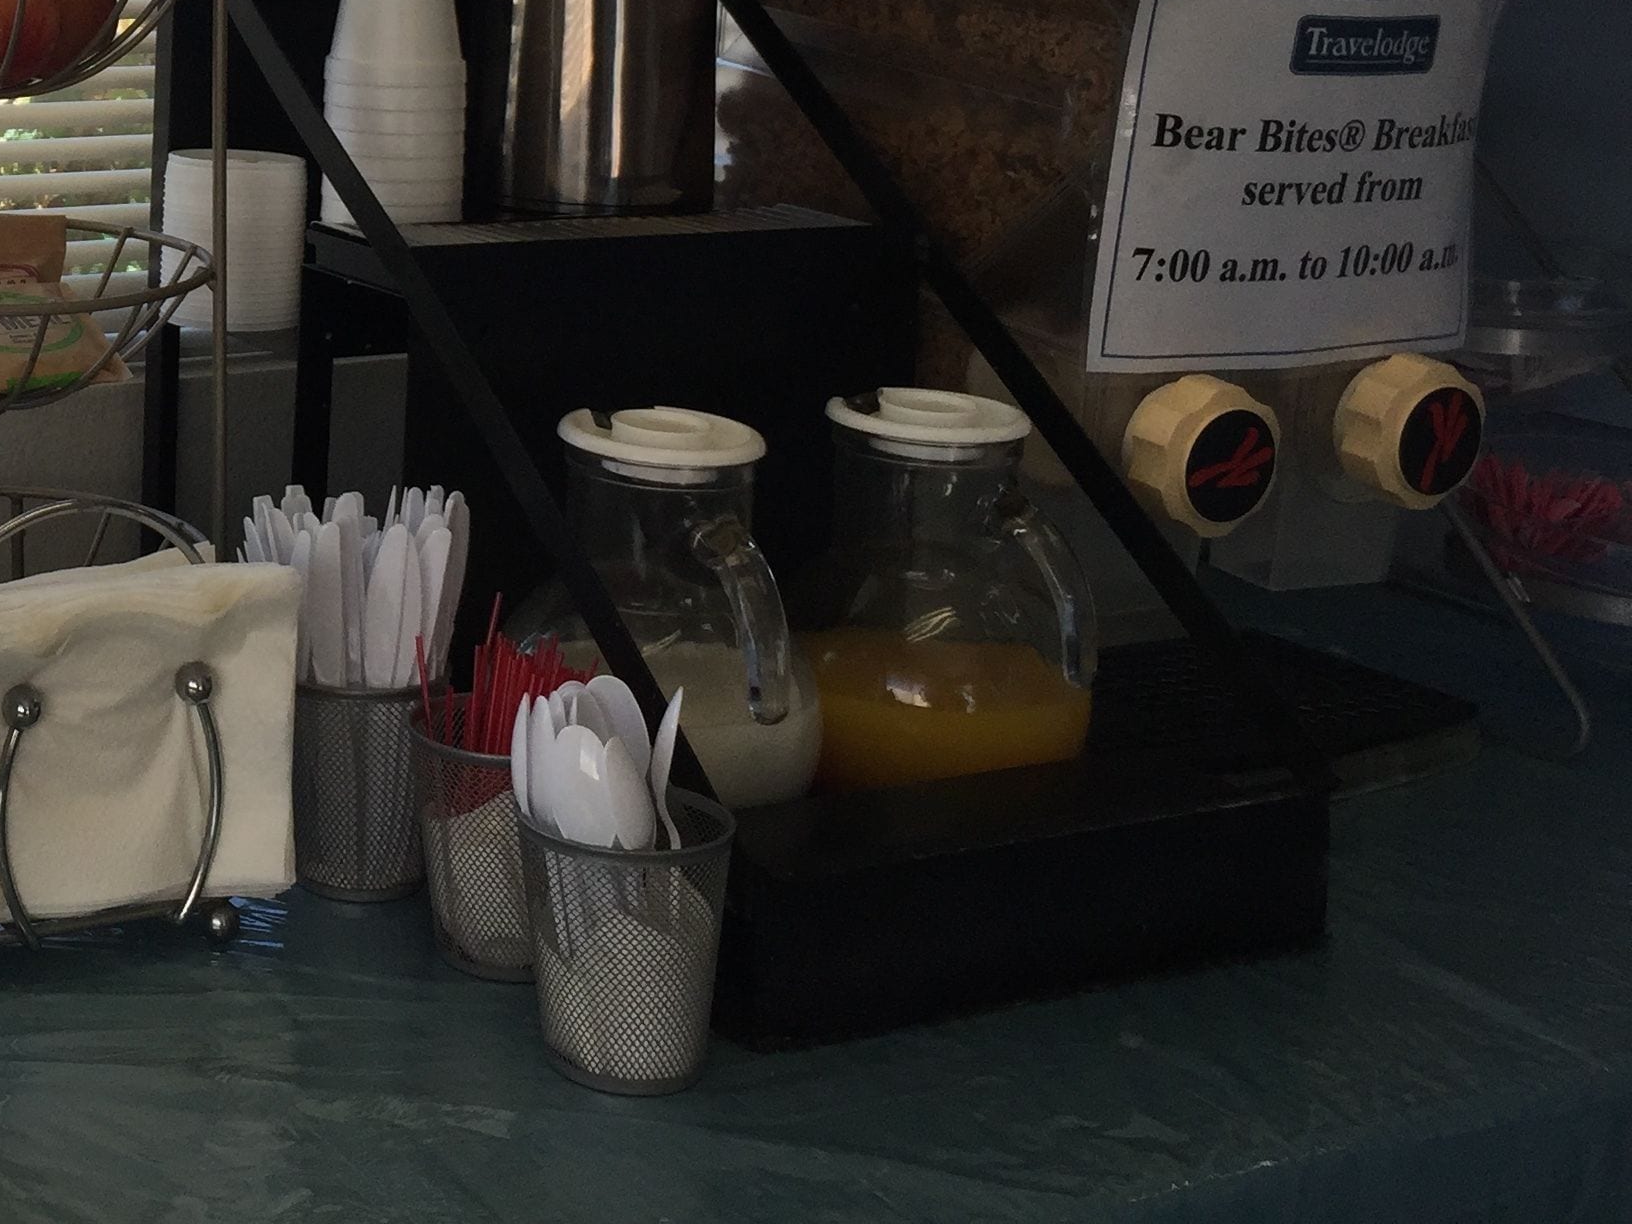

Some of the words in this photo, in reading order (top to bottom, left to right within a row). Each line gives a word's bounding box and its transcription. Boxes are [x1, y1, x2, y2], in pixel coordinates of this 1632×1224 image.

[1307, 25, 1431, 65] Travelodge
[1152, 113, 1246, 152] Bear
[1241, 172, 1348, 207] served
[1353, 170, 1423, 203] from
[1131, 247, 1210, 282] 7:00
[1219, 257, 1287, 282] a.m.
[1298, 250, 1327, 280] to
[1337, 241, 1413, 279] 10:00
